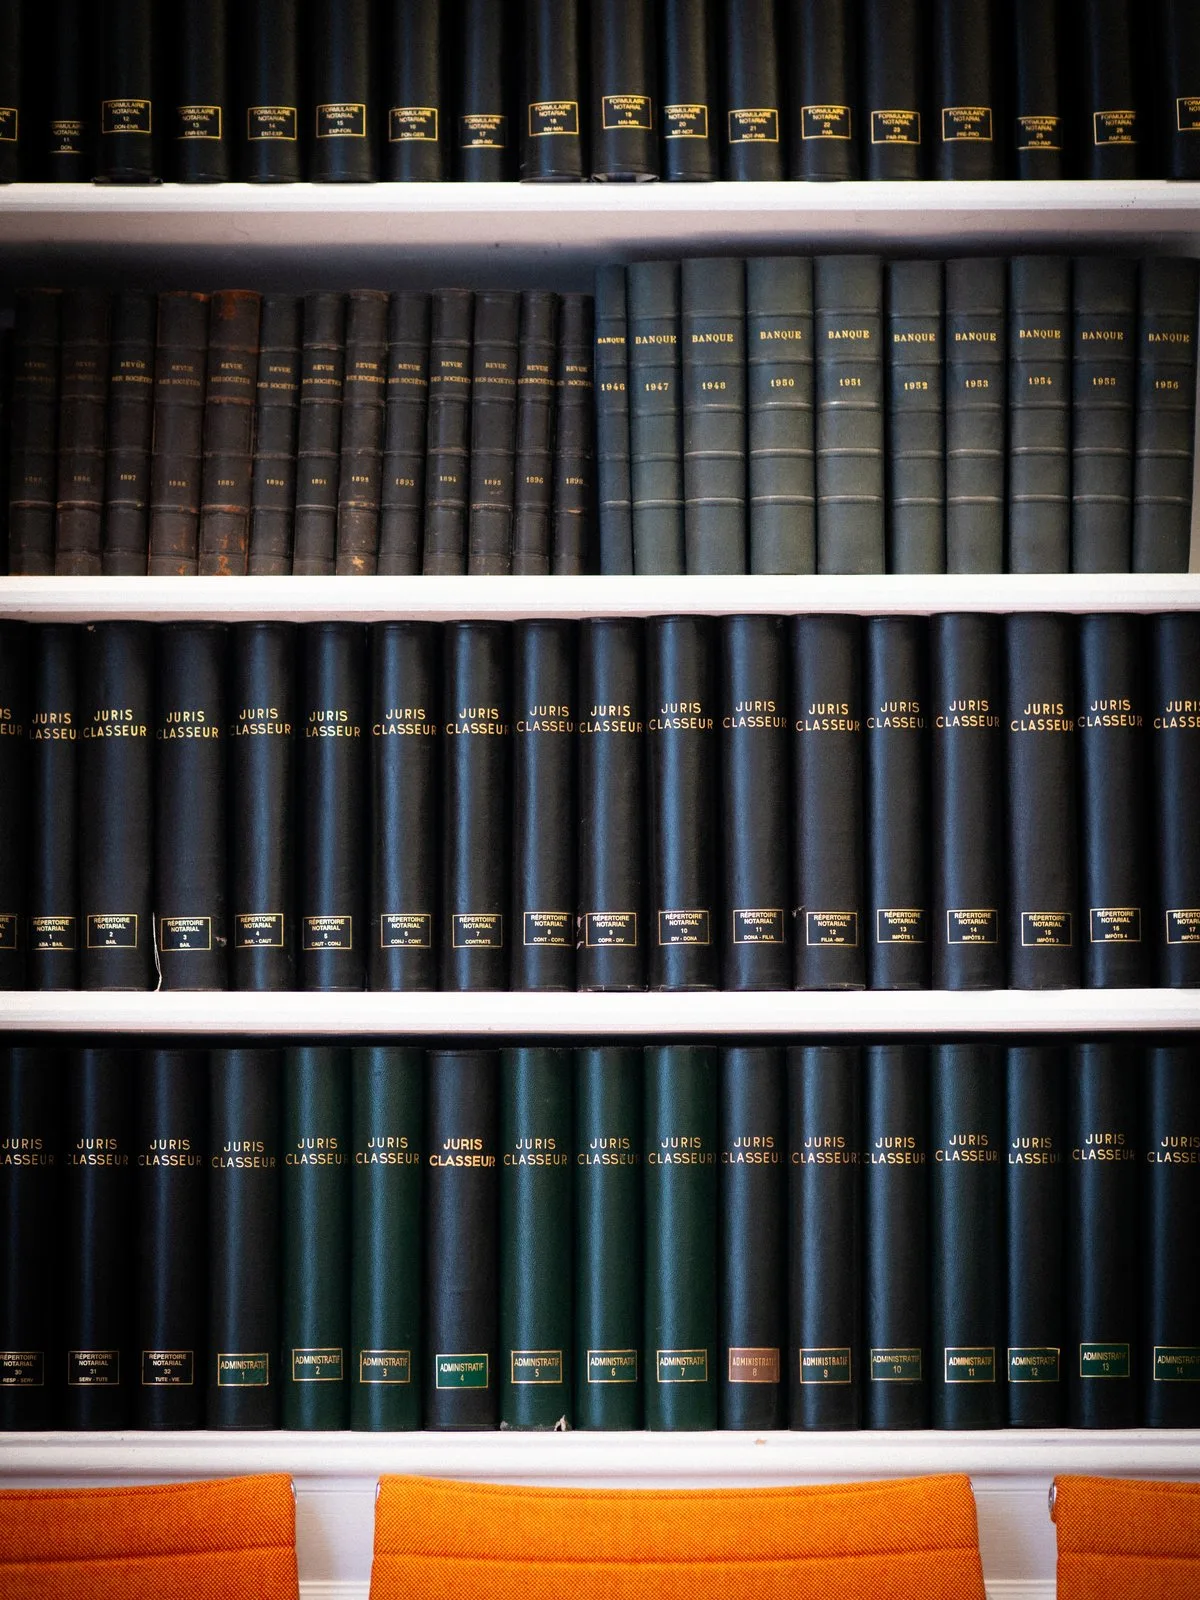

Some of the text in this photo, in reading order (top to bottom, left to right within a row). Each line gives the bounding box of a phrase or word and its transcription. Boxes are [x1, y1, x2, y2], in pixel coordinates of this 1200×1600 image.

[636, 335, 676, 344] BANQUE
[692, 334, 733, 343] BANQUE
[760, 331, 801, 339] BANQUE
[829, 330, 869, 339] BANQUE
[894, 333, 935, 342] BANQUE
[955, 333, 996, 341] BANQUE
[1020, 330, 1060, 339] BANQUE
[1082, 332, 1123, 340] BANQUE
[1149, 333, 1189, 342] BANQUE
[702, 382, 726, 390] 1948
[770, 379, 795, 387] 1950
[840, 378, 861, 386] 1951
[904, 381, 928, 390] 1952
[965, 379, 989, 388] 1953
[1028, 377, 1052, 385] 1954
[1092, 377, 1116, 385] 1955
[1155, 381, 1179, 390] 1956
[601, 383, 625, 391] 1946
[645, 383, 669, 391] 1947
[591, 705, 630, 716] JURIS
[661, 703, 701, 713] JURIS
[736, 701, 775, 712] JURIS
[809, 704, 848, 715] JURIS
[881, 702, 919, 712] JURIS
[949, 700, 988, 711] JURIS
[1024, 704, 1063, 715] JURIS
[1091, 700, 1130, 711] JURIS
[94, 709, 132, 721] JURIS
[240, 708, 278, 719] JURIS
[310, 711, 347, 721] JURIS
[386, 709, 425, 720] JURIS
[459, 708, 498, 719] JURIS
[530, 706, 569, 717] JURIS
[33, 713, 71, 724] JURIS
[167, 711, 204, 723] JURIS
[723, 716, 786, 728] CLASSEUR
[936, 715, 999, 728] CLASSEUR
[1078, 715, 1142, 727] CLASSEUR
[580, 721, 642, 733] CLASSEUR
[649, 718, 713, 730] CLASSEUR
[796, 719, 859, 731] CLASSEUR
[1011, 719, 1073, 731] CLASSEUR
[84, 725, 146, 737] CLASSEUR
[373, 724, 436, 735] CLASSEUR
[94, 916, 130, 924] RÉPERTOIRE
[530, 913, 568, 921] RÉPERTOIRE
[168, 919, 204, 927] RÉPERTOIRE
[2, 1139, 42, 1149] JURIS
[77, 1139, 116, 1149] JURIS
[298, 1138, 337, 1149] JURIS
[368, 1137, 408, 1148] JURIS
[444, 1139, 482, 1150] JURIS
[516, 1139, 555, 1149] JURIS
[590, 1138, 630, 1149] JURIS
[662, 1137, 701, 1148] JURIS
[734, 1137, 773, 1147] JURIS
[805, 1137, 845, 1147] JURIS
[875, 1137, 915, 1148] JURIS
[949, 1135, 988, 1145] JURIS
[1013, 1138, 1051, 1148] JURIS
[1085, 1134, 1126, 1145] JURIS
[150, 1140, 190, 1150] JURIS
[224, 1141, 264, 1152] JURIS
[356, 1153, 419, 1164] CLASSEUR
[504, 1154, 567, 1165] CLASSEUR
[1072, 1149, 1136, 1161] CLASSEUR
[212, 1157, 274, 1168] CLASSEUR
[429, 1155, 495, 1166] CLASSEUR
[221, 1360, 266, 1369] ADMINISTRATIF
[295, 1355, 340, 1364] ADMINISTRATIF
[362, 1357, 408, 1366] ADMINISTRATIF
[514, 1358, 560, 1366] ADMINISTRATIF
[590, 1357, 635, 1365] ADMINISTRATIF
[660, 1357, 704, 1365] ADMINISTRATIF
[803, 1357, 848, 1365] ADMINISTRATIF
[949, 1356, 992, 1365] ADMINISTRATIF
[1012, 1356, 1056, 1365] ADMINISTRATIF
[316, 1366, 320, 1375] 2
[383, 1368, 387, 1376] 3
[440, 1363, 484, 1371] ADMINISTRATIF
[612, 1368, 615, 1376] 6
[681, 1367, 685, 1376] 7
[753, 1368, 757, 1376] 8
[968, 1368, 974, 1376] 11
[1031, 1368, 1038, 1376] 12
[242, 1371, 245, 1380] 1
